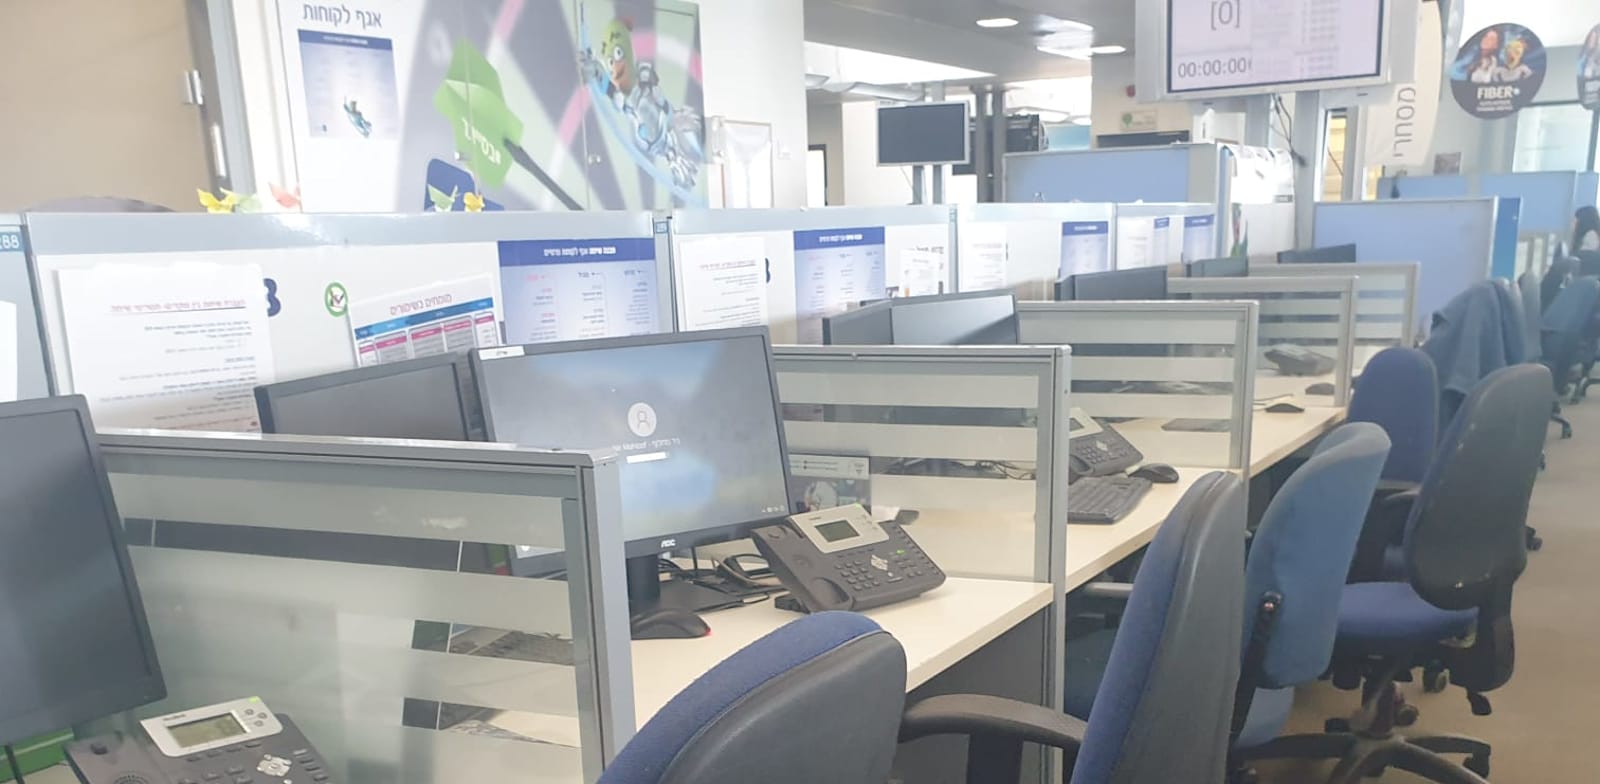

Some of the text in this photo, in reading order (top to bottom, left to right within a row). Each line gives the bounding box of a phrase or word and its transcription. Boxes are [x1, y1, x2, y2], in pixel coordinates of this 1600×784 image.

[303, 4, 382, 30] אגף לקוחות
[1477, 86, 1513, 100] FIBER
